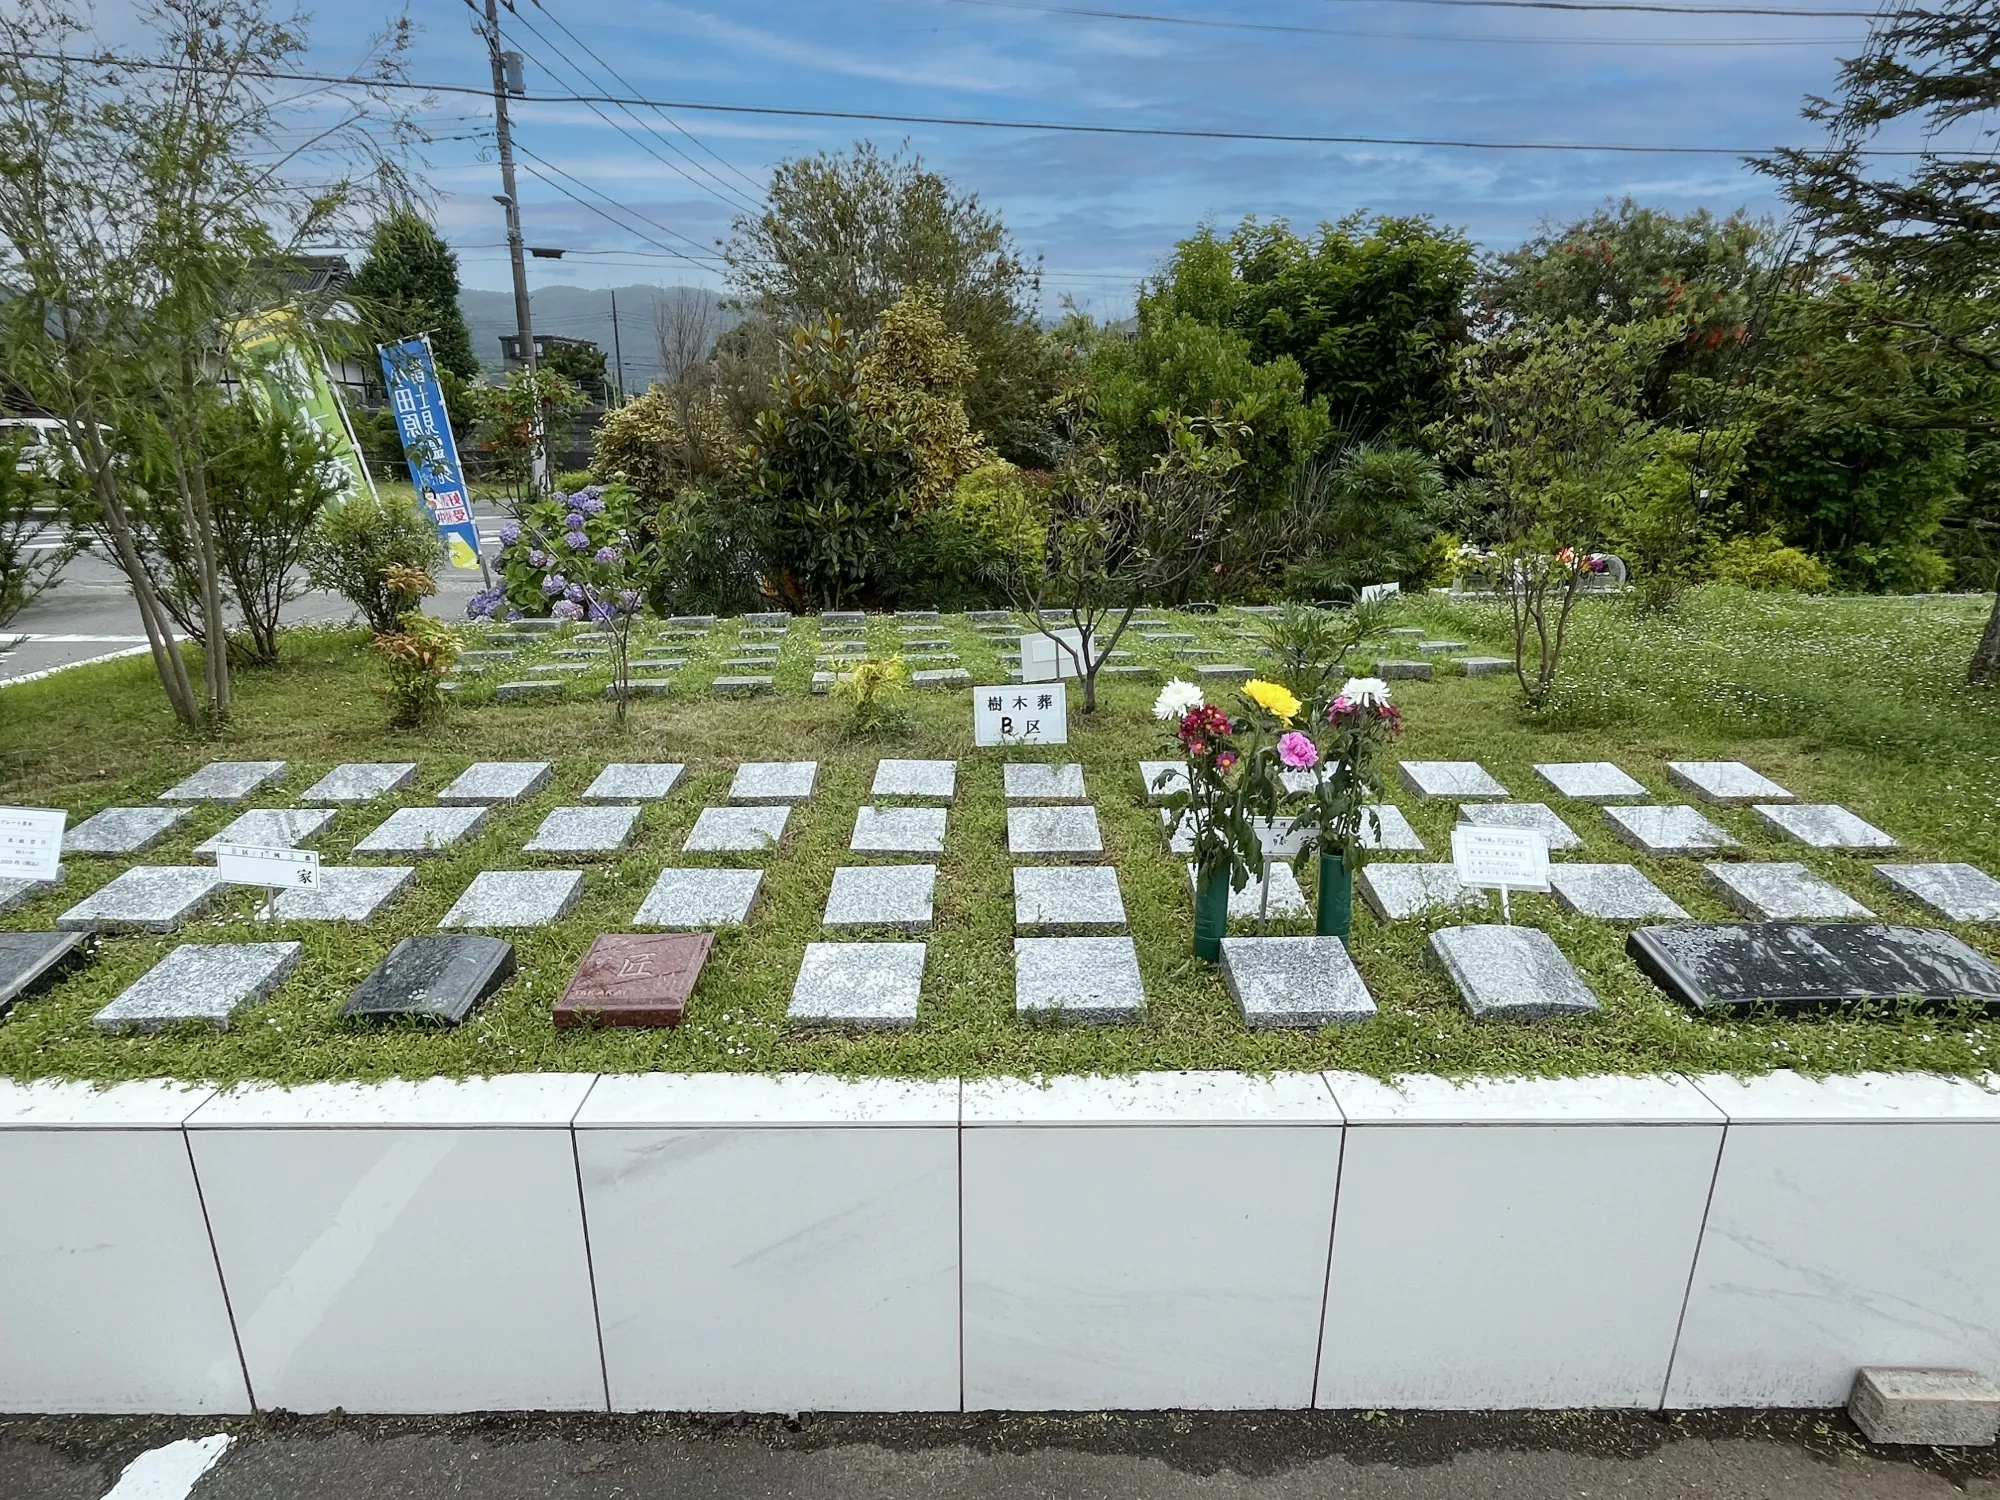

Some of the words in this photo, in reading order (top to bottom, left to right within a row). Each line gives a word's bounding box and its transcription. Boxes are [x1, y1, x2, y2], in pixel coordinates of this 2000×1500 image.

[987, 694, 1053, 712] 樹木葬
[297, 868, 313, 884] 家
[616, 951, 657, 978] 匠
